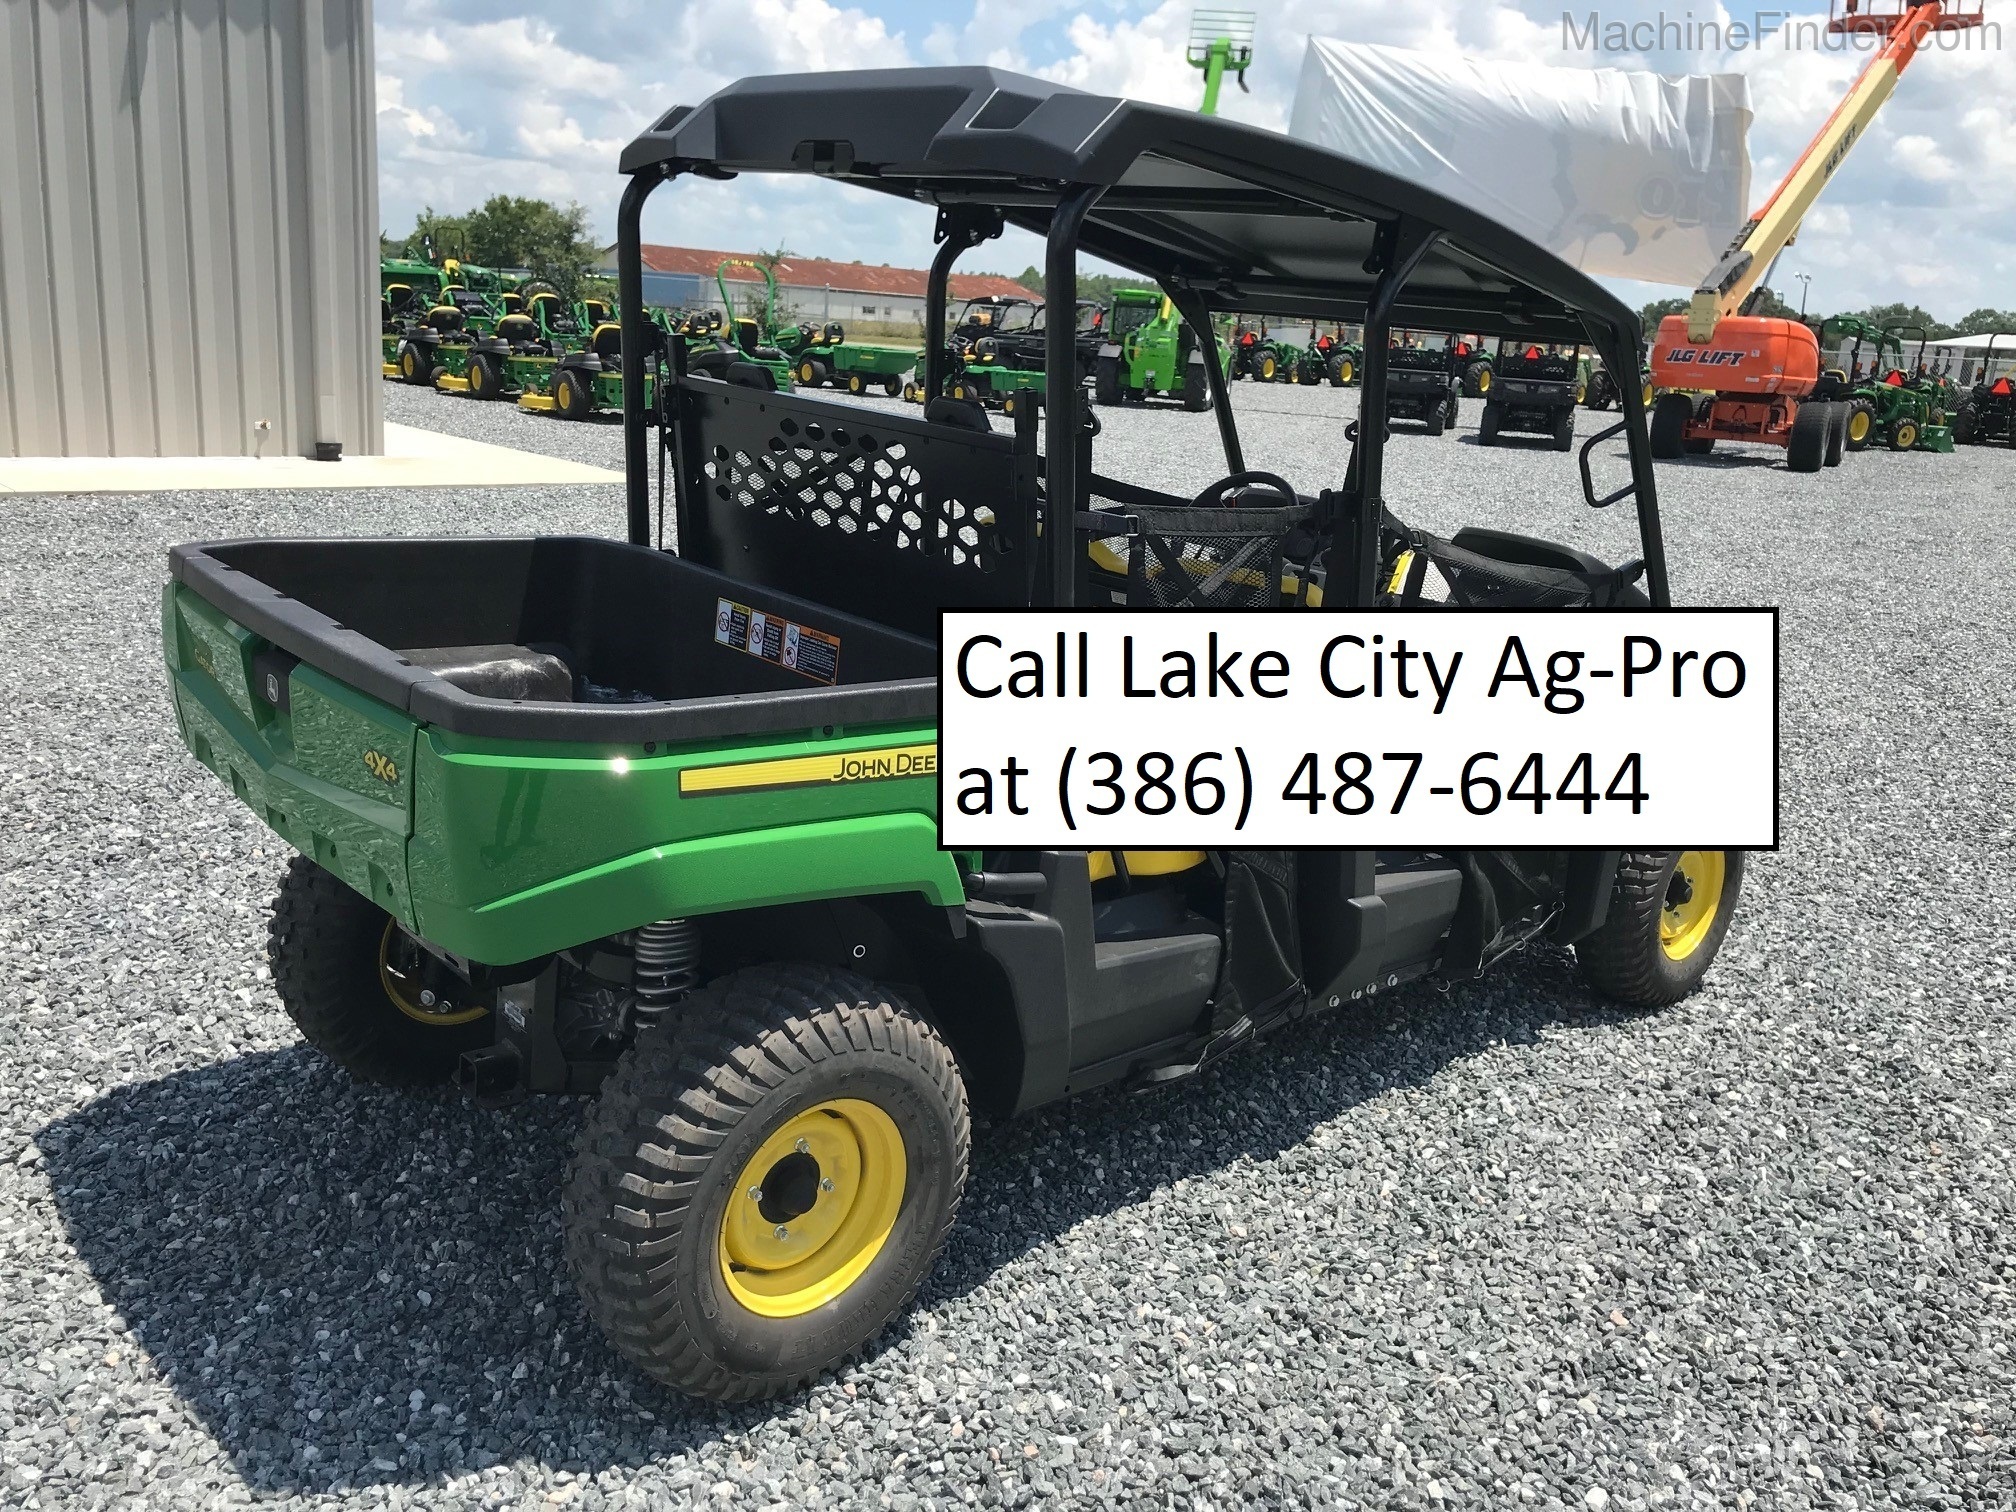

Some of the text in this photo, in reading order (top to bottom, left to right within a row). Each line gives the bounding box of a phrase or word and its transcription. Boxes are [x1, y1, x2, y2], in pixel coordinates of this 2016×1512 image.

[1665, 349, 1746, 367] JLG LIFT
[833, 753, 937, 778] JOHN DEE
